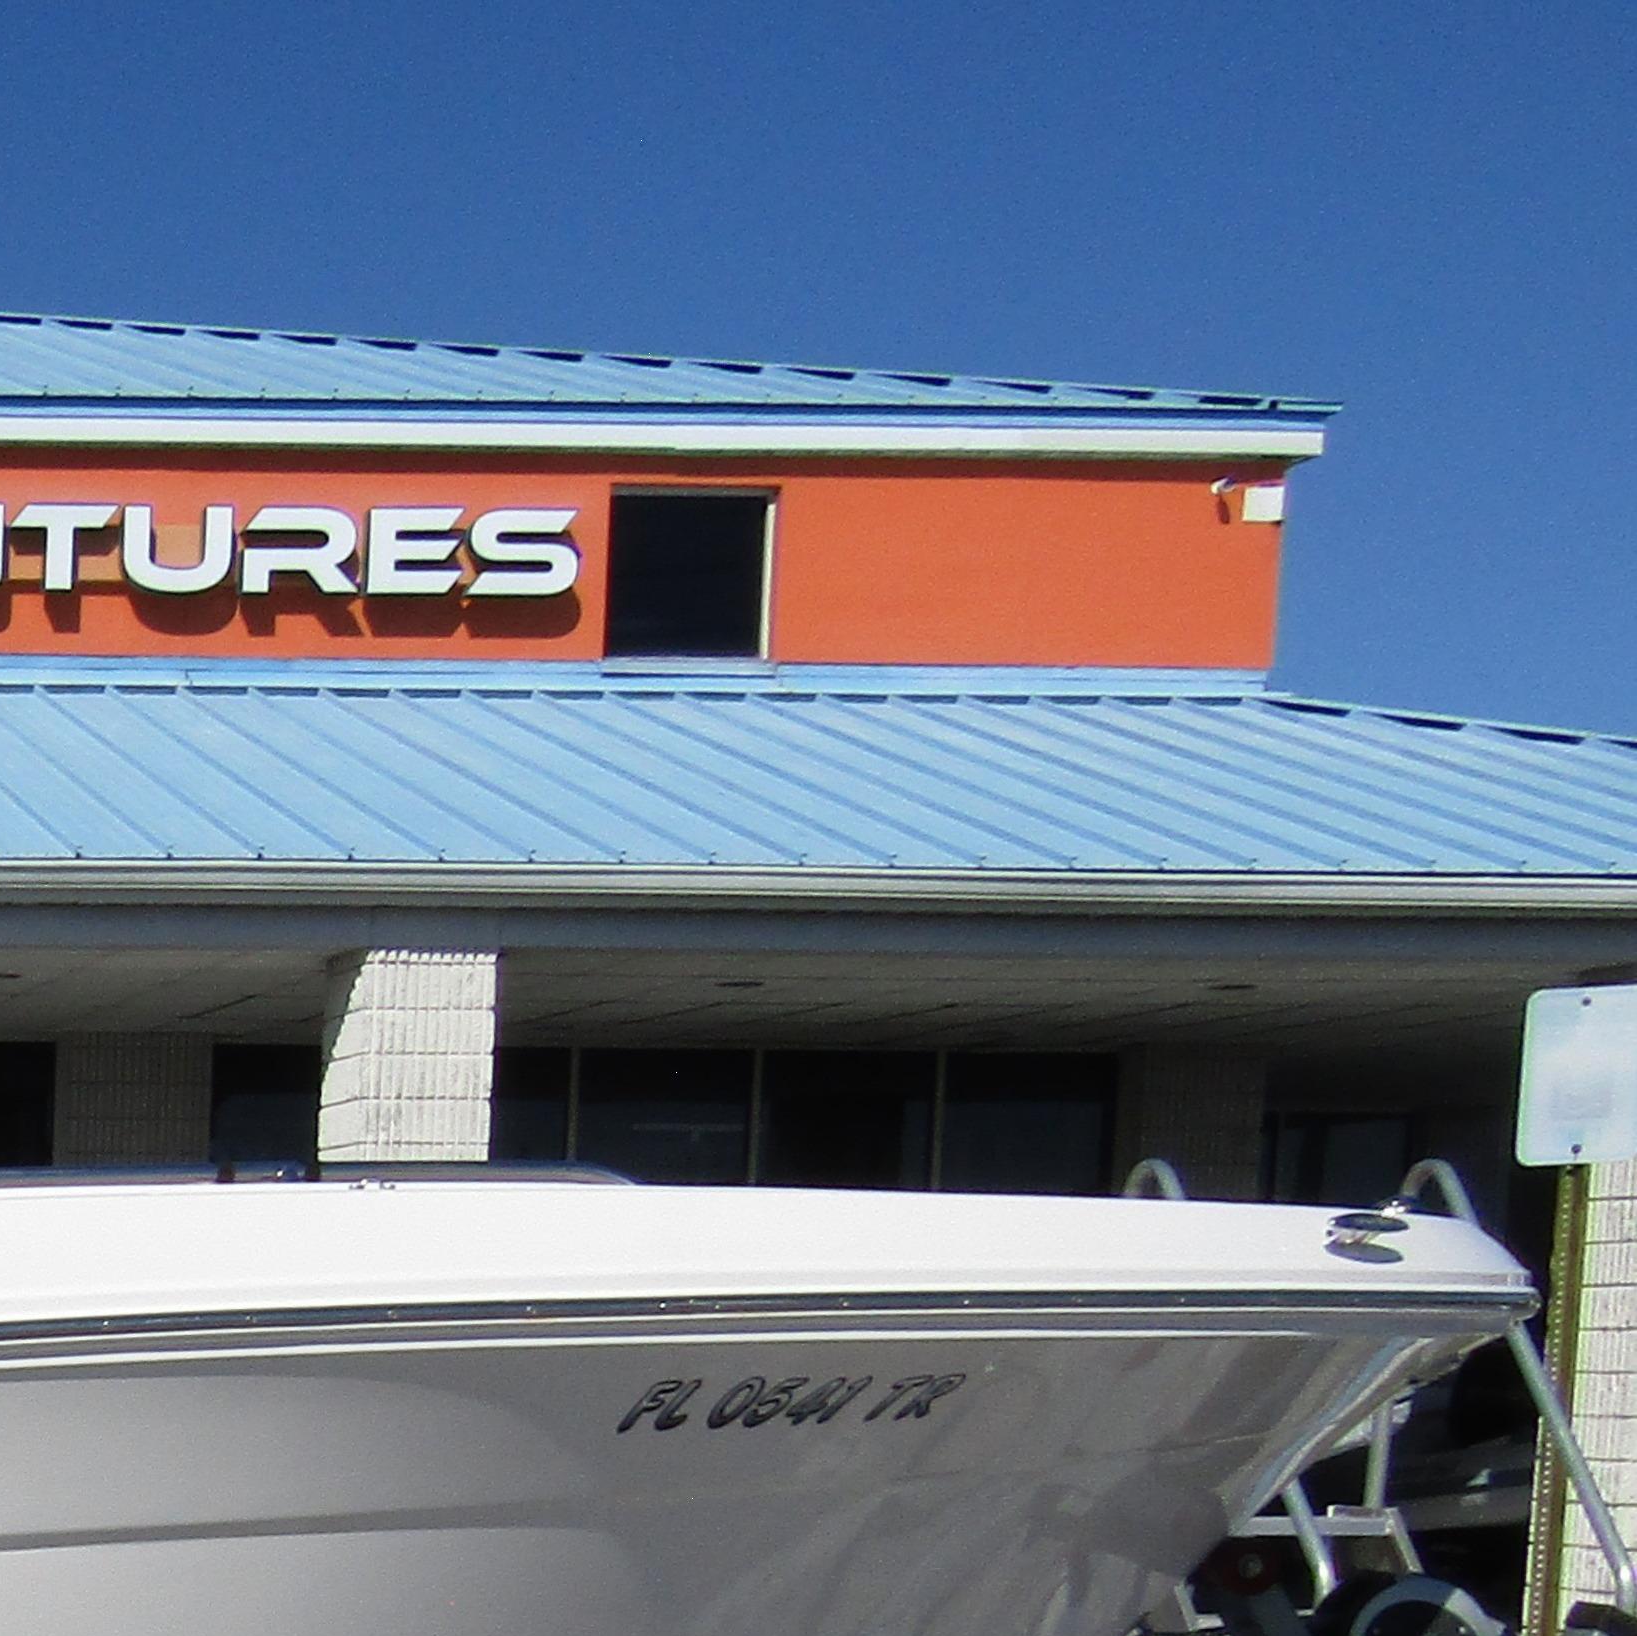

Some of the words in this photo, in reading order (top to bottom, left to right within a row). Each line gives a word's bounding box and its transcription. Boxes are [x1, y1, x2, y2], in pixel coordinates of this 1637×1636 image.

[617, 1379, 703, 1434] FL
[707, 1375, 873, 1429] 0541
[863, 1373, 967, 1422] TR
